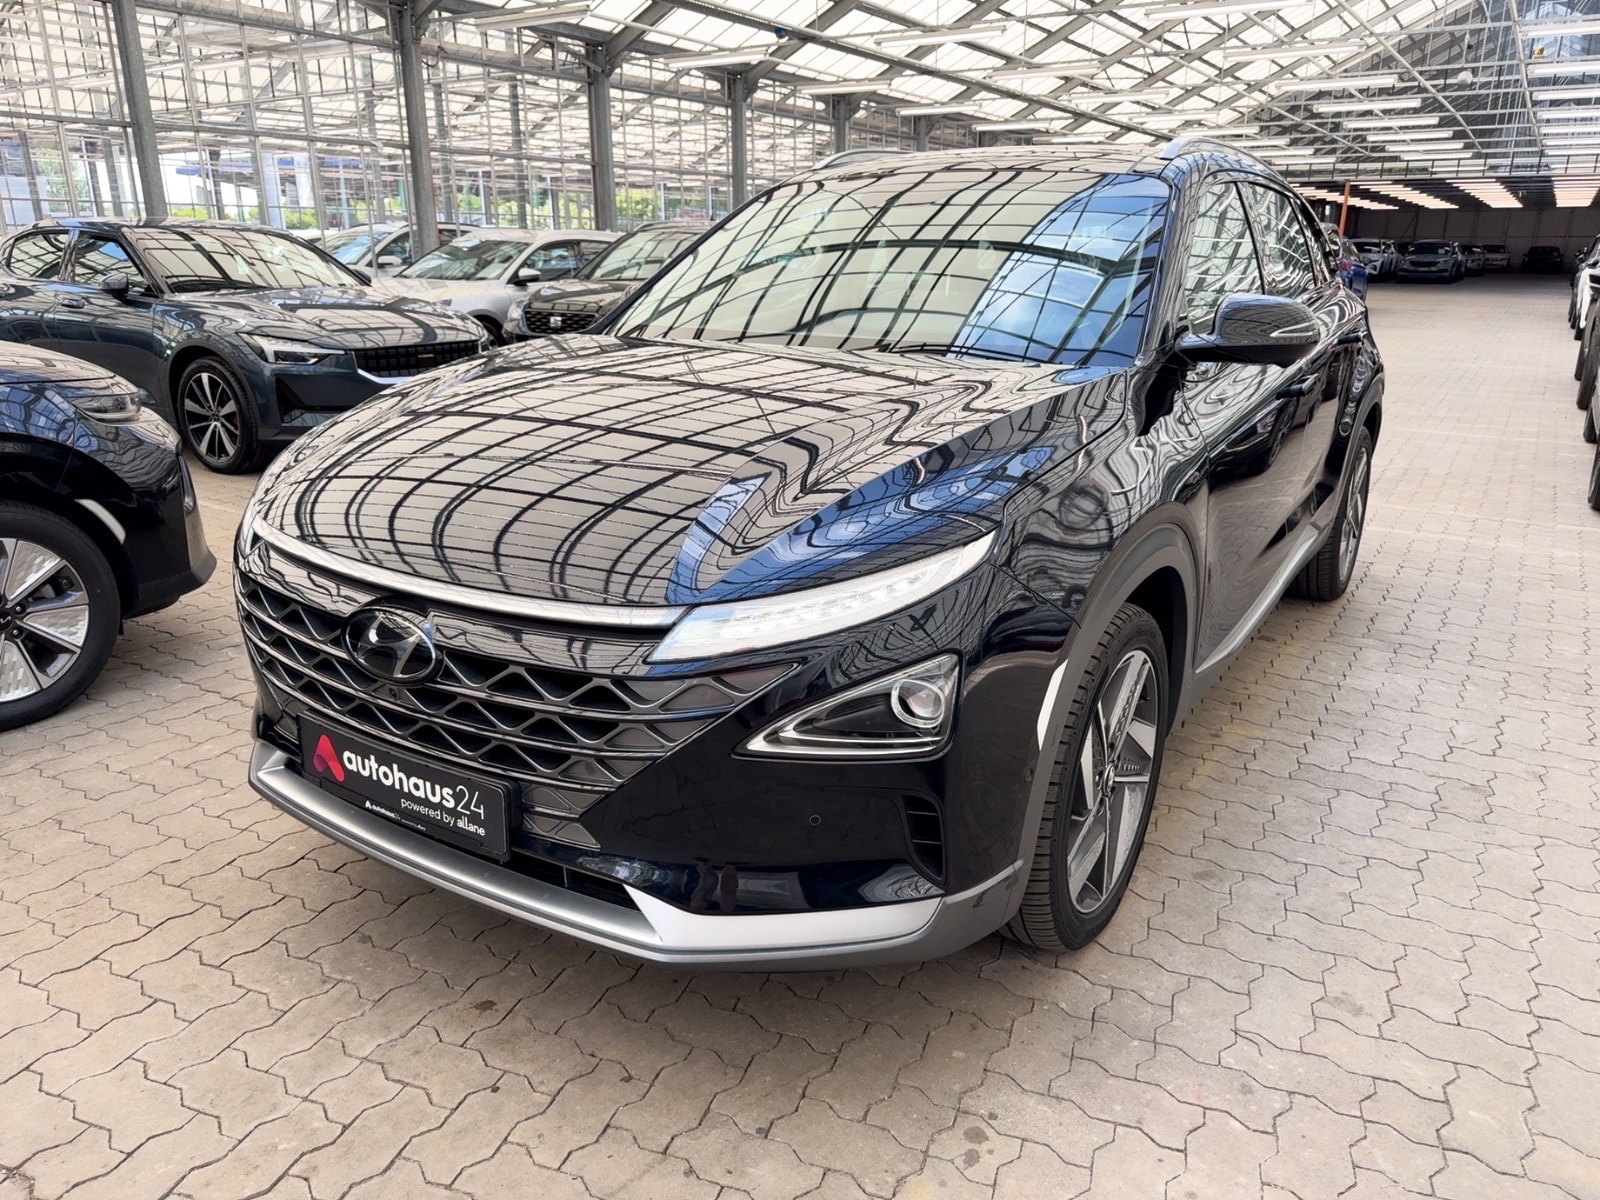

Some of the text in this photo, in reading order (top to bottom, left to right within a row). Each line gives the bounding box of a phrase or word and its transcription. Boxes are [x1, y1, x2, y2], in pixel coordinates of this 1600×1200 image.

[342, 750, 485, 820] autohaus24
[400, 798, 441, 820] powered
[442, 810, 455, 827] by
[456, 815, 486, 836] allane
